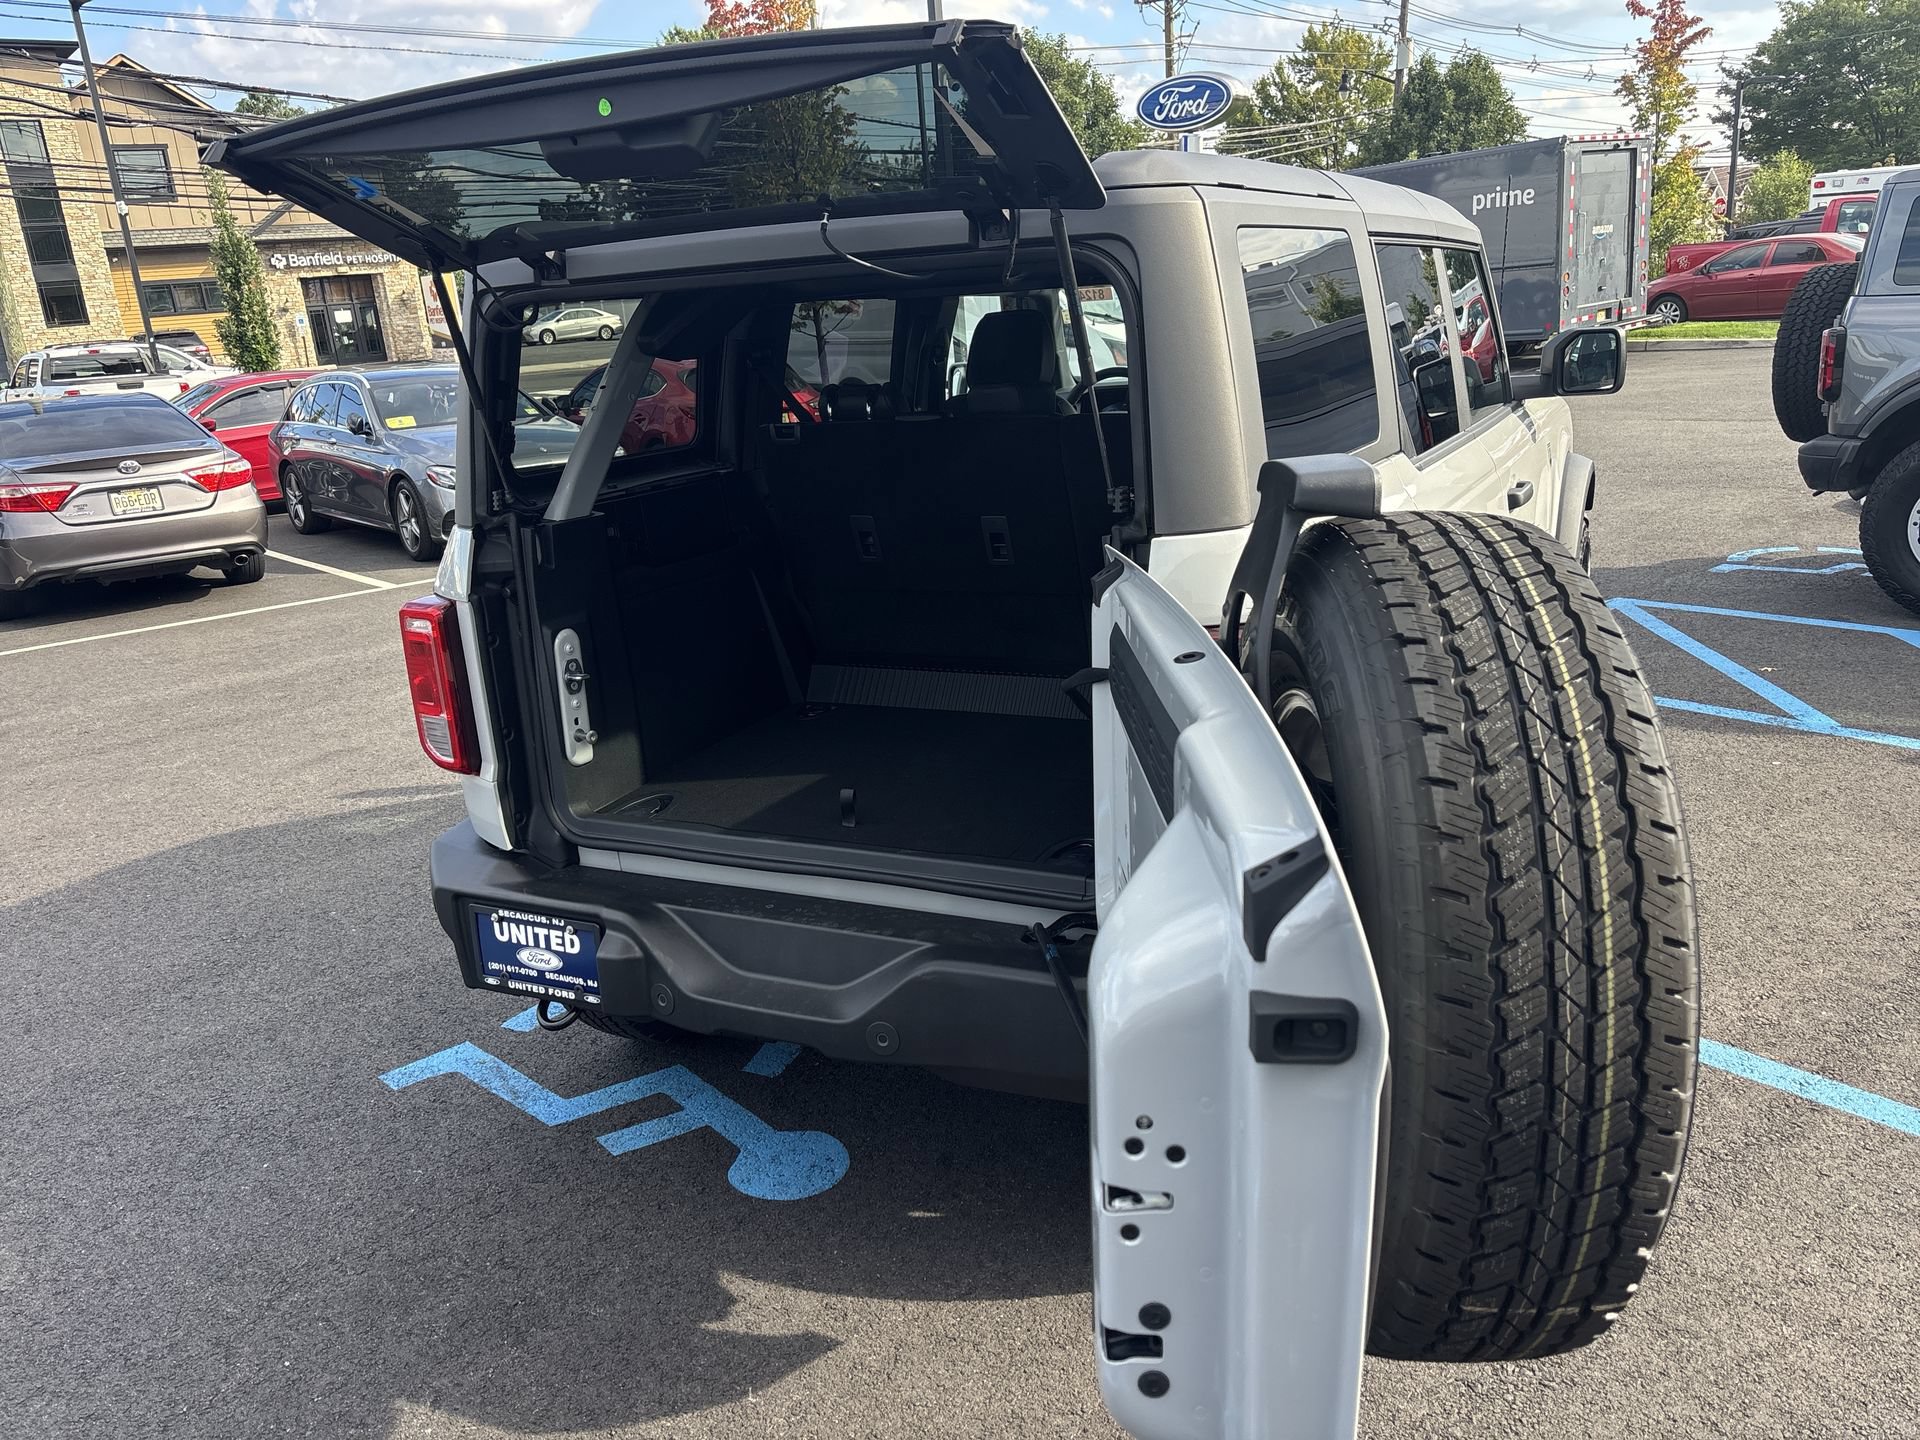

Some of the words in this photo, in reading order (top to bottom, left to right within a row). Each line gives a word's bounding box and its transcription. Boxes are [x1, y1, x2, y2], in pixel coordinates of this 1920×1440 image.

[1154, 84, 1211, 121] Ford
[1472, 186, 1535, 216] prime
[288, 251, 343, 267] Banfield
[346, 255, 363, 264] PET
[498, 909, 550, 924] SECAUCUS,
[552, 918, 565, 926] NJ
[493, 920, 581, 955] UNITED
[526, 951, 552, 966] Ford
[488, 961, 506, 972] (201)
[545, 972, 587, 987] SECAUCUS,
[587, 979, 598, 988] NJ
[508, 980, 546, 994] UNITED
[548, 988, 576, 1000] FORD
